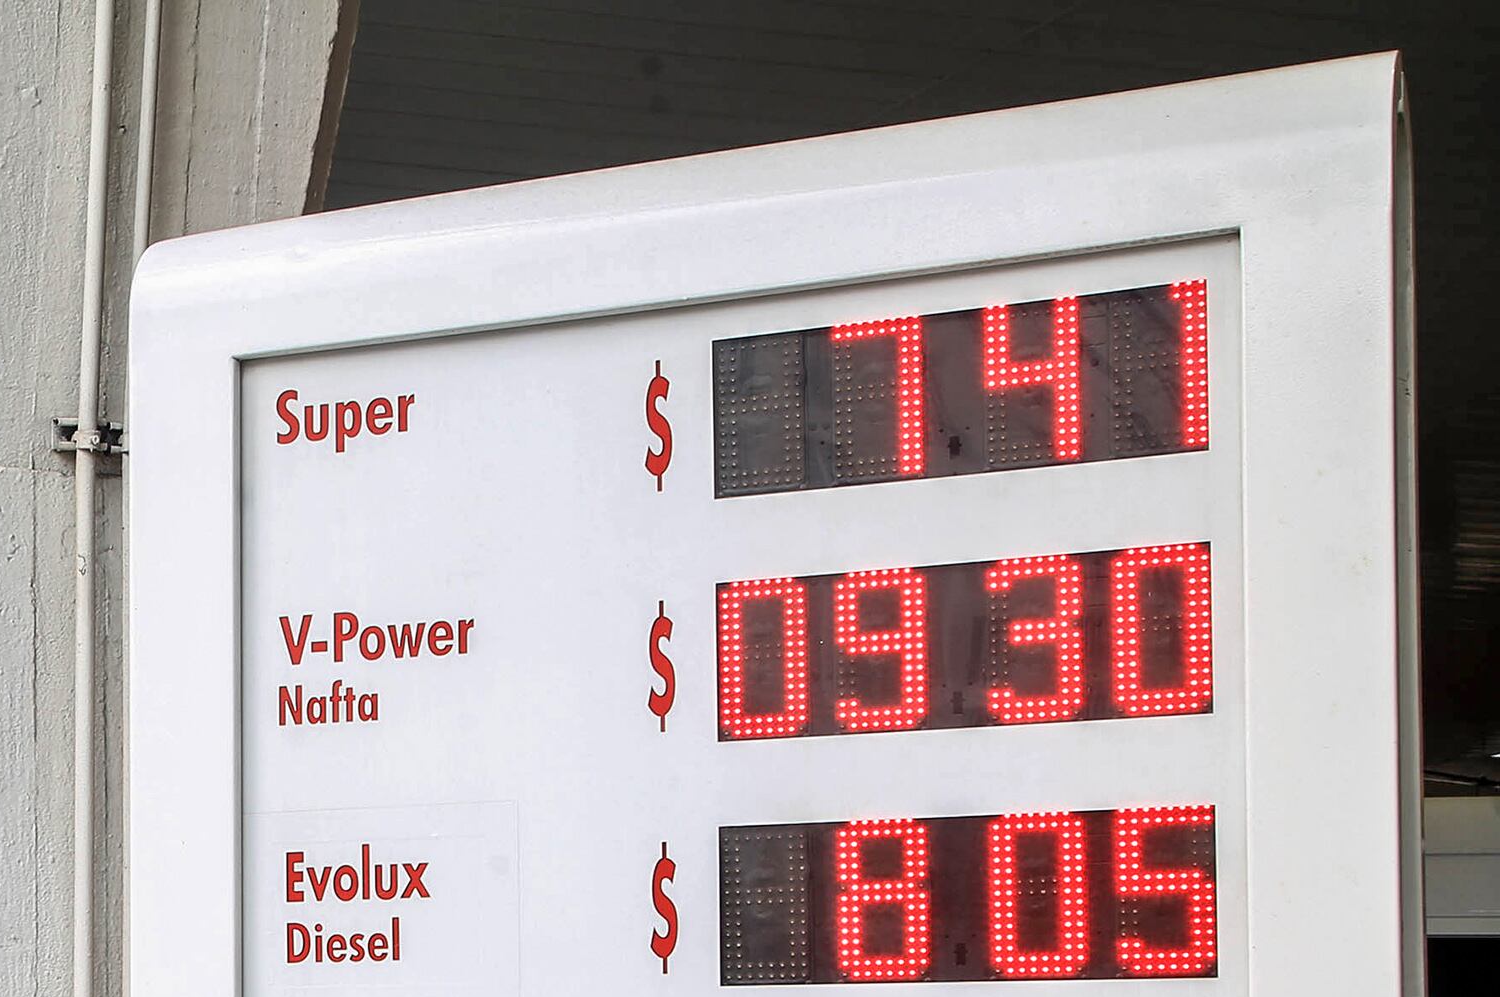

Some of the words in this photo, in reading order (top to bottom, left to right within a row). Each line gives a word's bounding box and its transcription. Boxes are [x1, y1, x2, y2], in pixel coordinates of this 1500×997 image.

[276, 389, 415, 453] Super
[645, 360, 673, 492] $
[279, 612, 475, 666] V-Power
[648, 600, 676, 732] $
[719, 542, 1213, 738] 0930
[279, 679, 379, 726] Nafta
[286, 843, 430, 903] Evolux
[650, 841, 678, 974] $
[835, 804, 1216, 981] 805
[286, 917, 400, 964] Diesel
